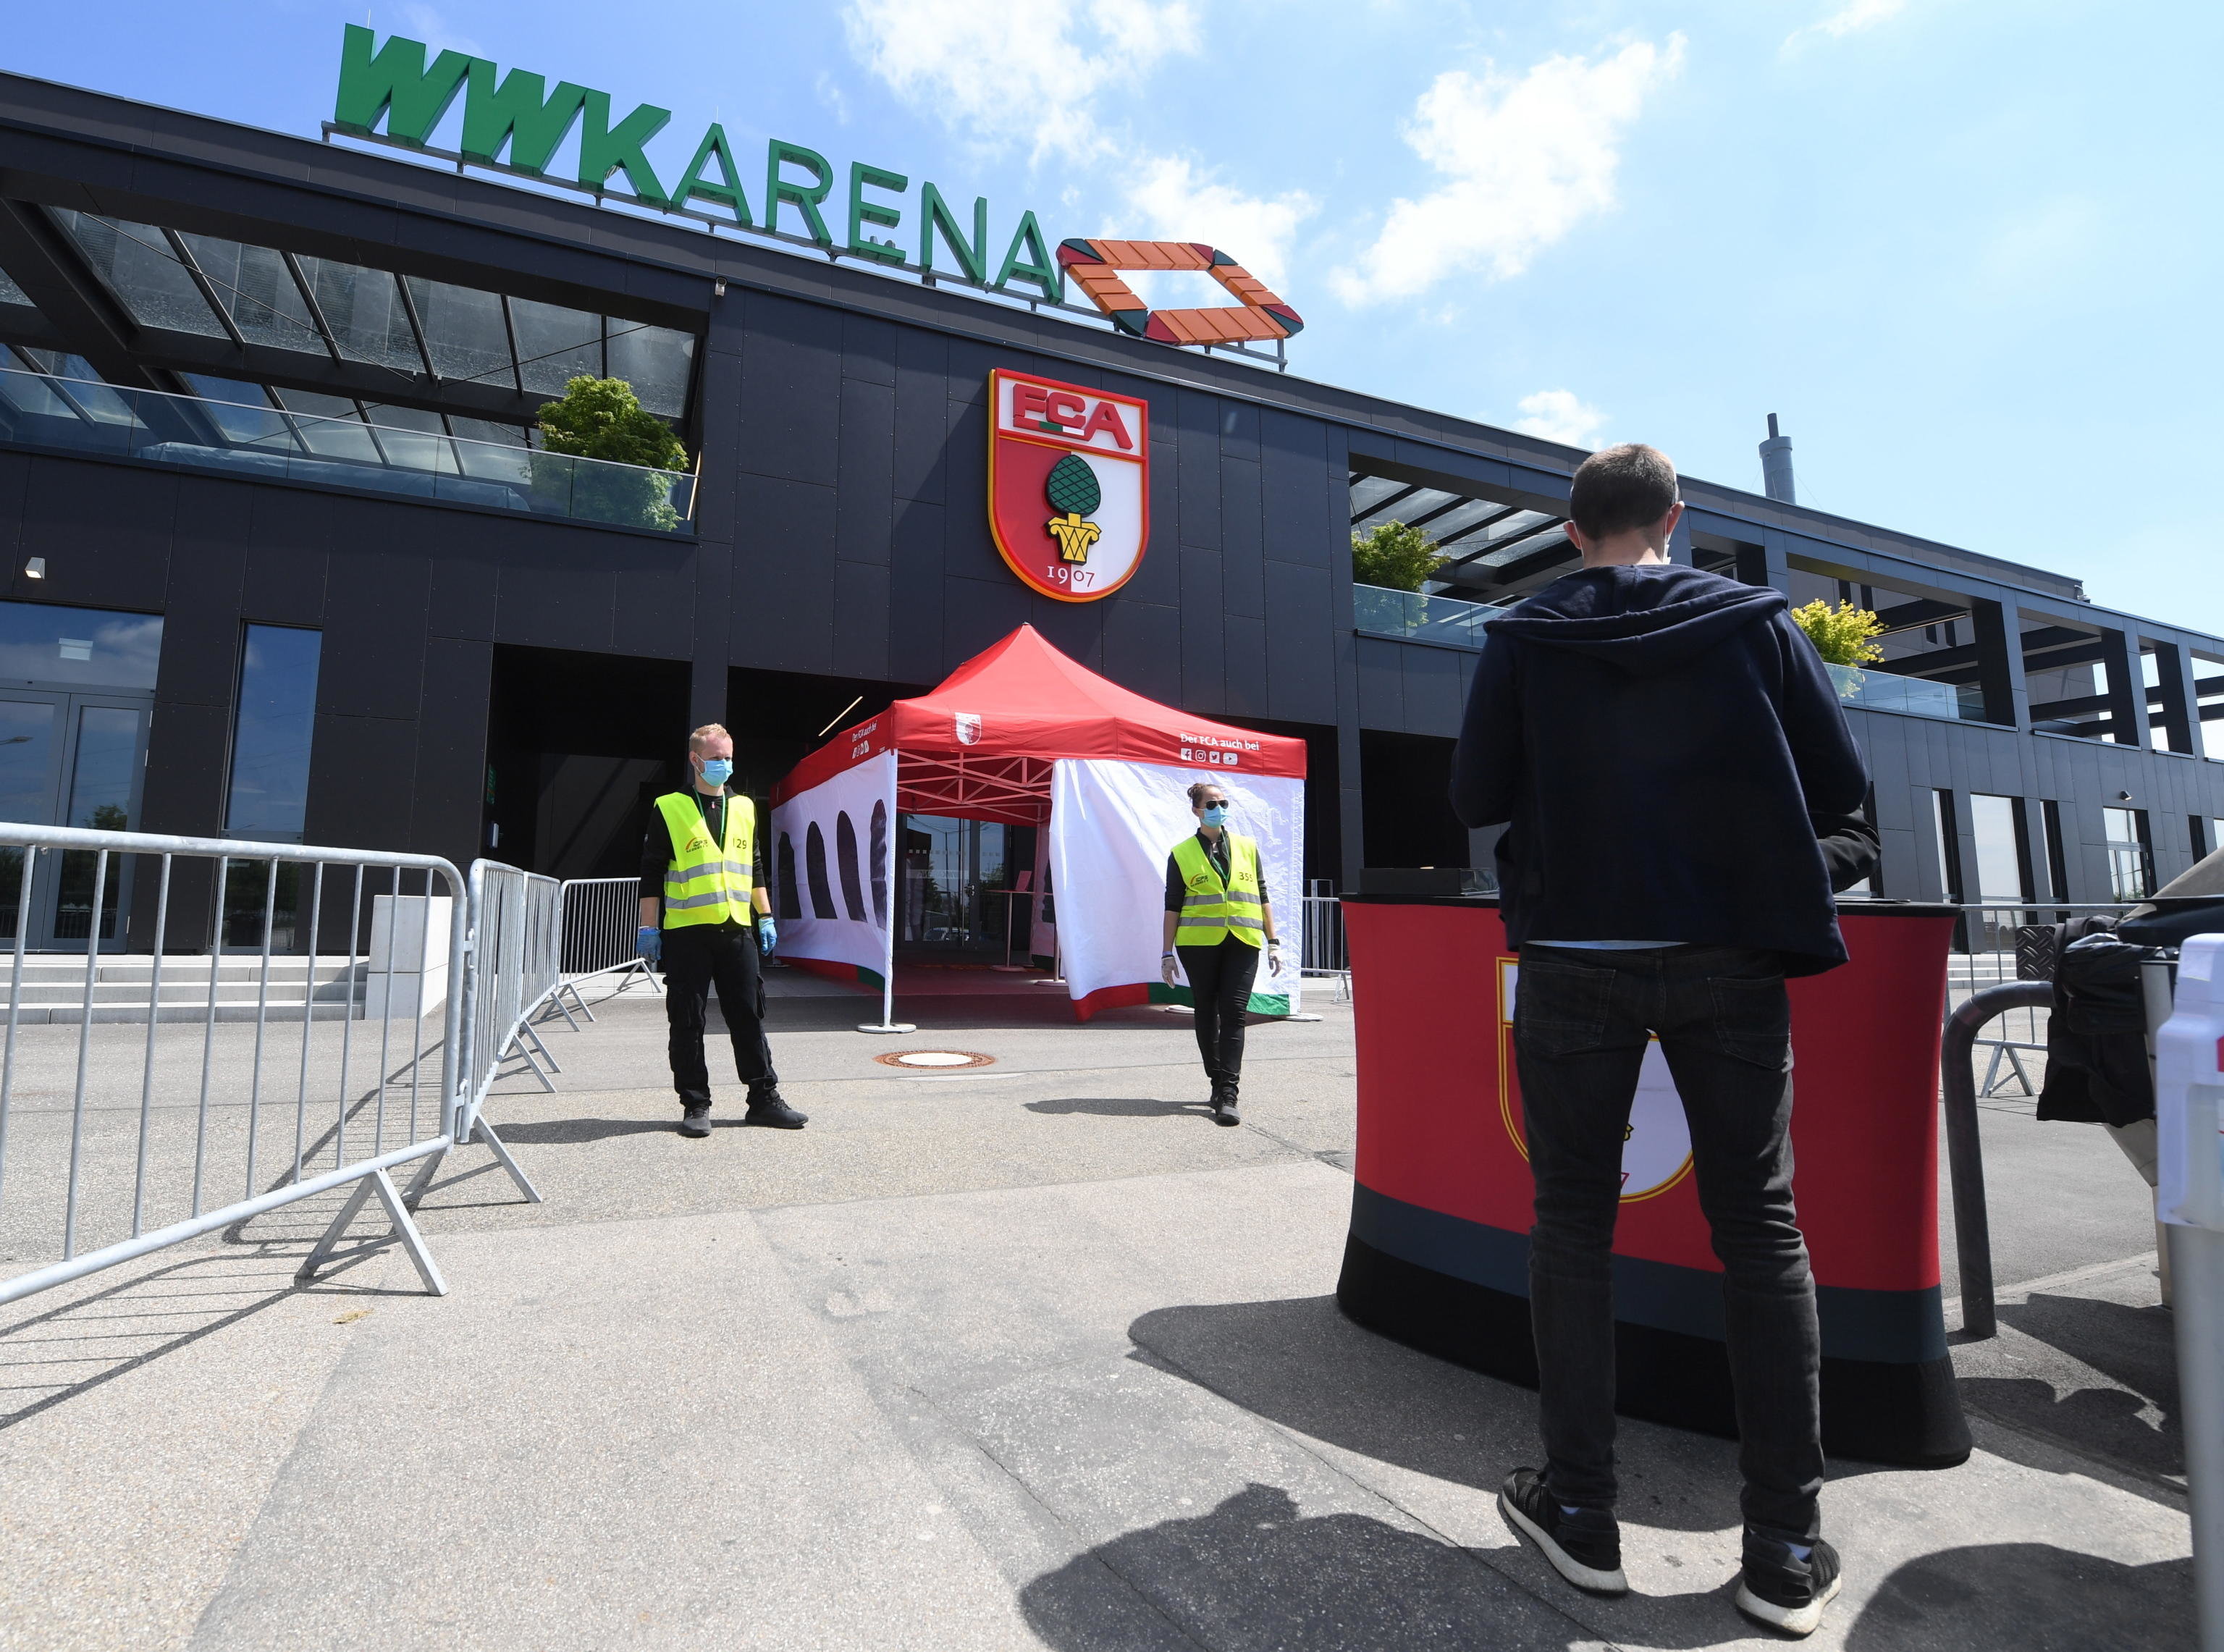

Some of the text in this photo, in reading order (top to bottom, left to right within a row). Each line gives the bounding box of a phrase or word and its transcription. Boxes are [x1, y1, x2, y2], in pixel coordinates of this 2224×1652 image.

[1012, 382, 1134, 450] FCA
[1047, 565, 1095, 588] 1907
[1180, 733, 1260, 751] Der FCA auch bei
[1239, 872, 1253, 882] 355
